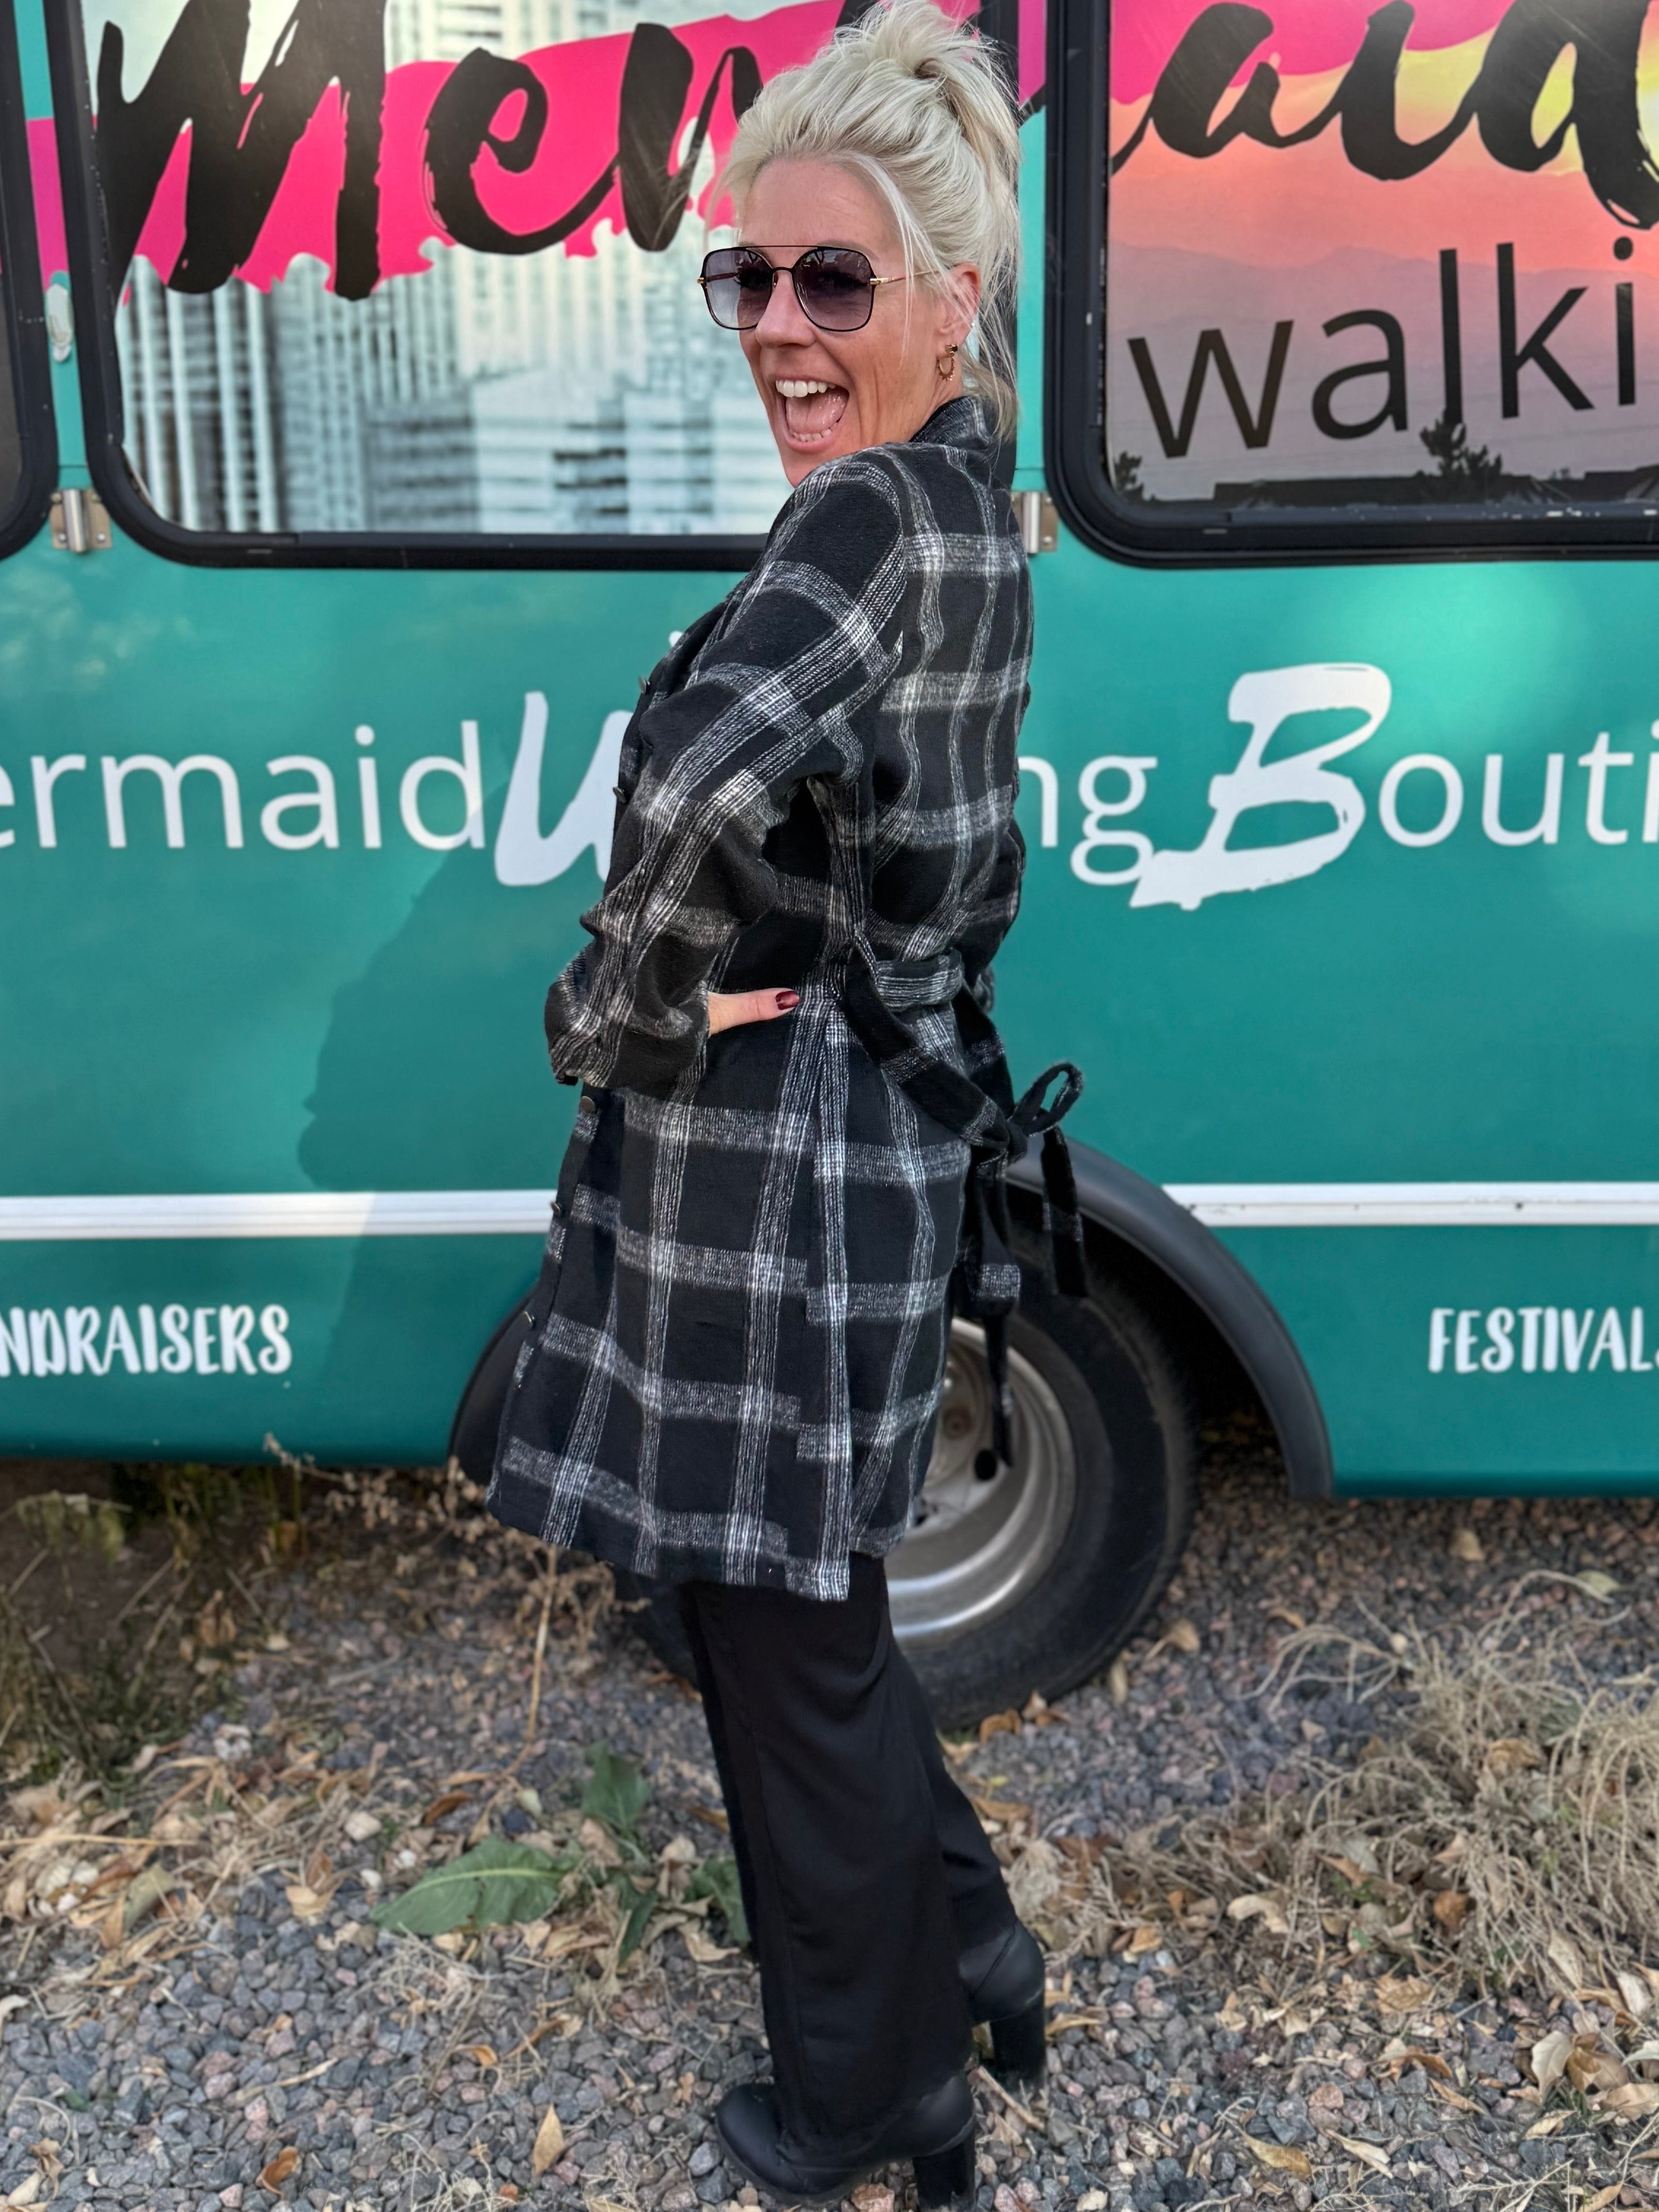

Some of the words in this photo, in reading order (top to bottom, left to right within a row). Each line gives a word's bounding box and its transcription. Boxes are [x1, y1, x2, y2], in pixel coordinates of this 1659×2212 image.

[1128, 237, 1636, 458] walki
[0, 721, 485, 851] rmaid
[1428, 1307, 1659, 1373] FESTIVAL
